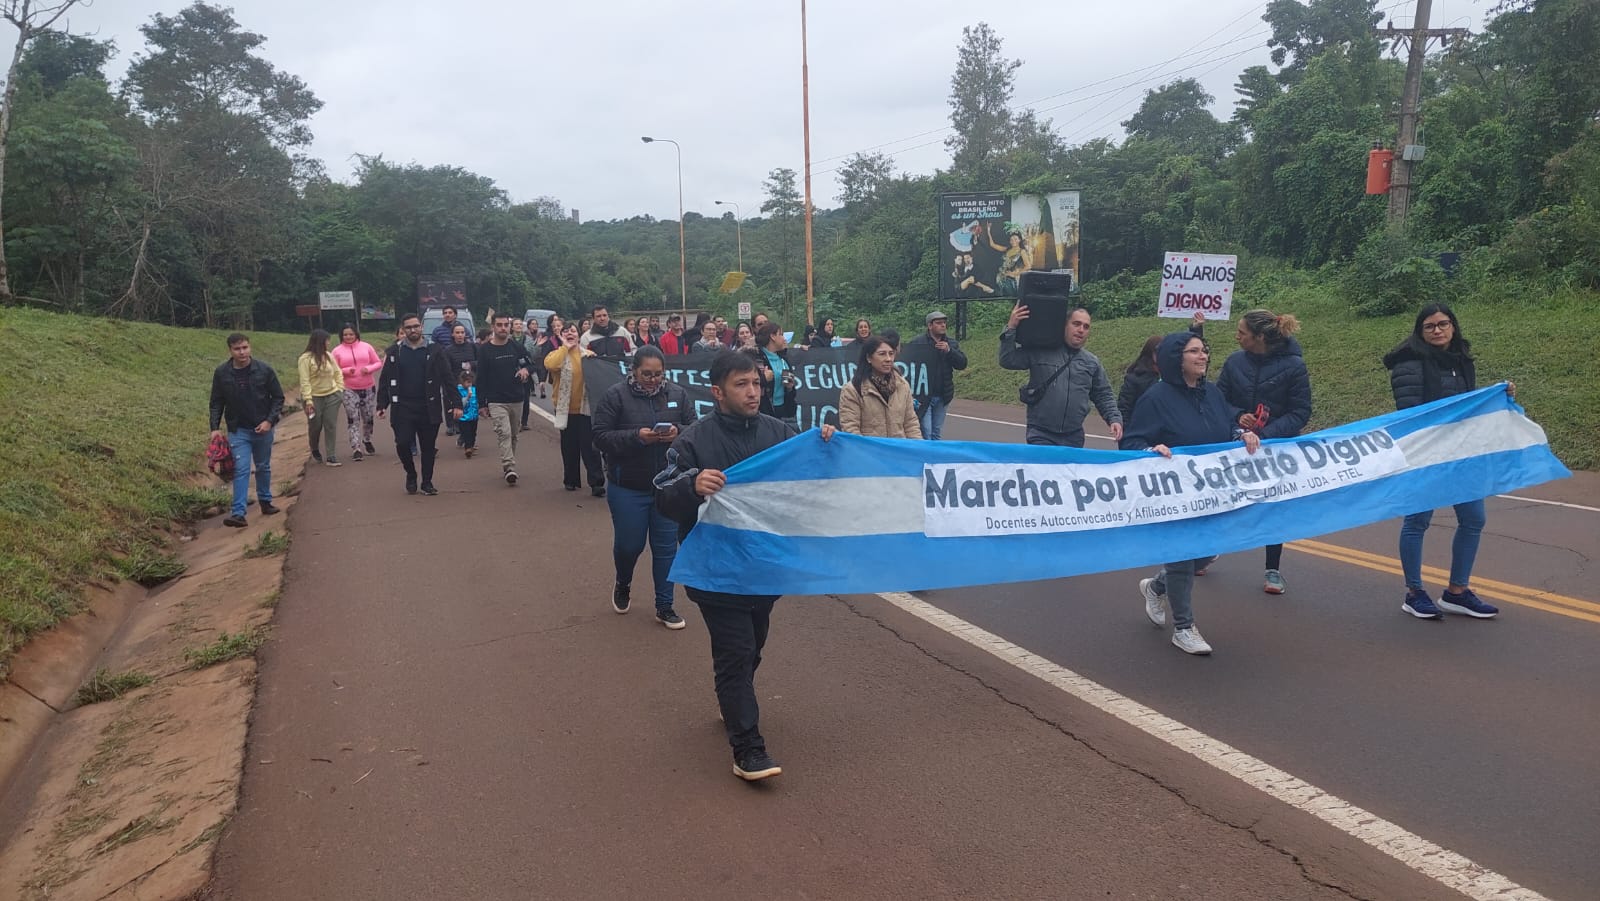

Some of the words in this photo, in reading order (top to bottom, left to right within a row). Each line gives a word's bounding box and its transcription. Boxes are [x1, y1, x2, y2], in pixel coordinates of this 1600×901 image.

[958, 205, 997, 213] BRASILEÑO
[1163, 264, 1236, 283] SALARIOS
[1165, 292, 1222, 310] DIGNOS
[925, 469, 1063, 508] Marcha
[1071, 474, 1128, 511] por
[1139, 469, 1182, 498] un
[1187, 448, 1299, 491] Salario
[1298, 429, 1394, 470] Digno
[985, 516, 1037, 530] Docentes
[1040, 511, 1124, 527] Autoconvocados
[1126, 511, 1132, 523] y
[1135, 504, 1179, 519] Afiliados
[1182, 504, 1188, 513] a
[1190, 495, 1220, 512] UDPM
[1307, 475, 1330, 489] UDA
[1337, 467, 1364, 482] FTEL
